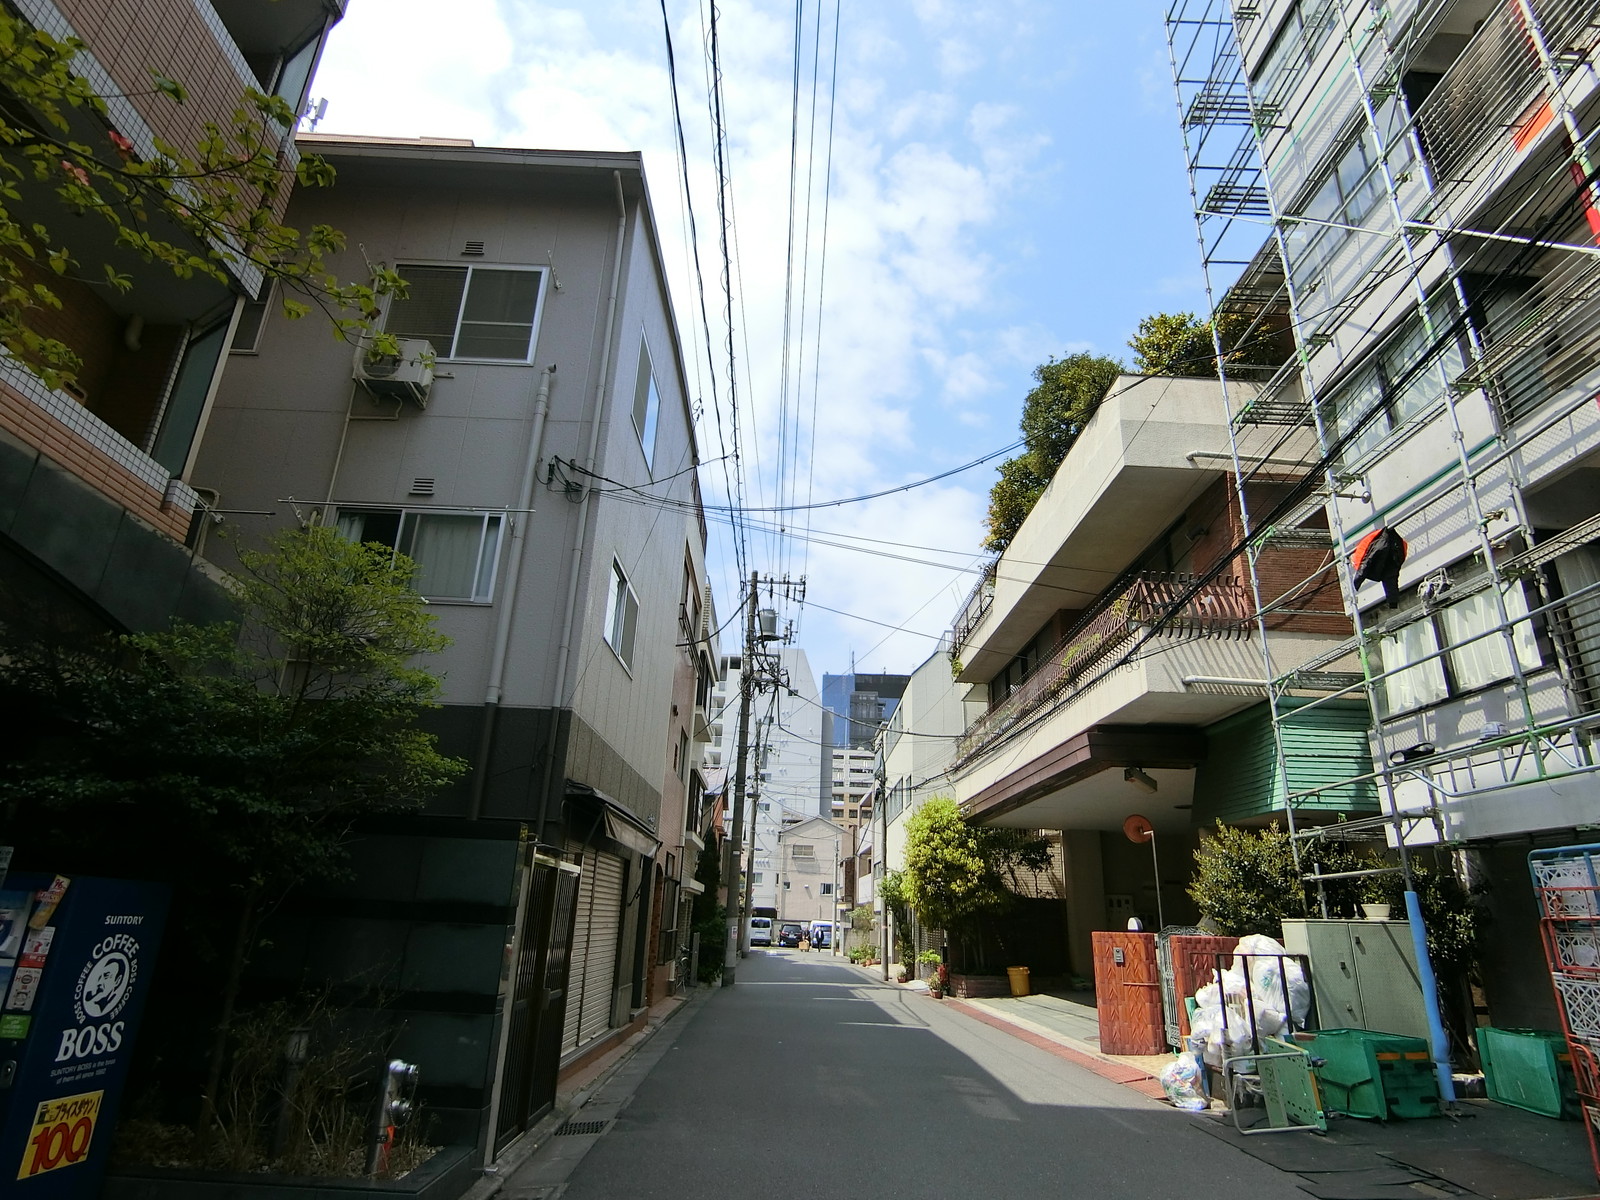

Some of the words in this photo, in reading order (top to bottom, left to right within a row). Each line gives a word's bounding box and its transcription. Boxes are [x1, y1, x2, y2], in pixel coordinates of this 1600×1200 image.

[104, 915, 145, 925] SUNTORY
[92, 933, 140, 960] COFFEE
[73, 961, 94, 1000] COFFEE
[130, 958, 138, 984] BOSS
[73, 1001, 86, 1025] BOSS
[110, 986, 132, 1020] COFFEE
[55, 1021, 125, 1063] BOSS
